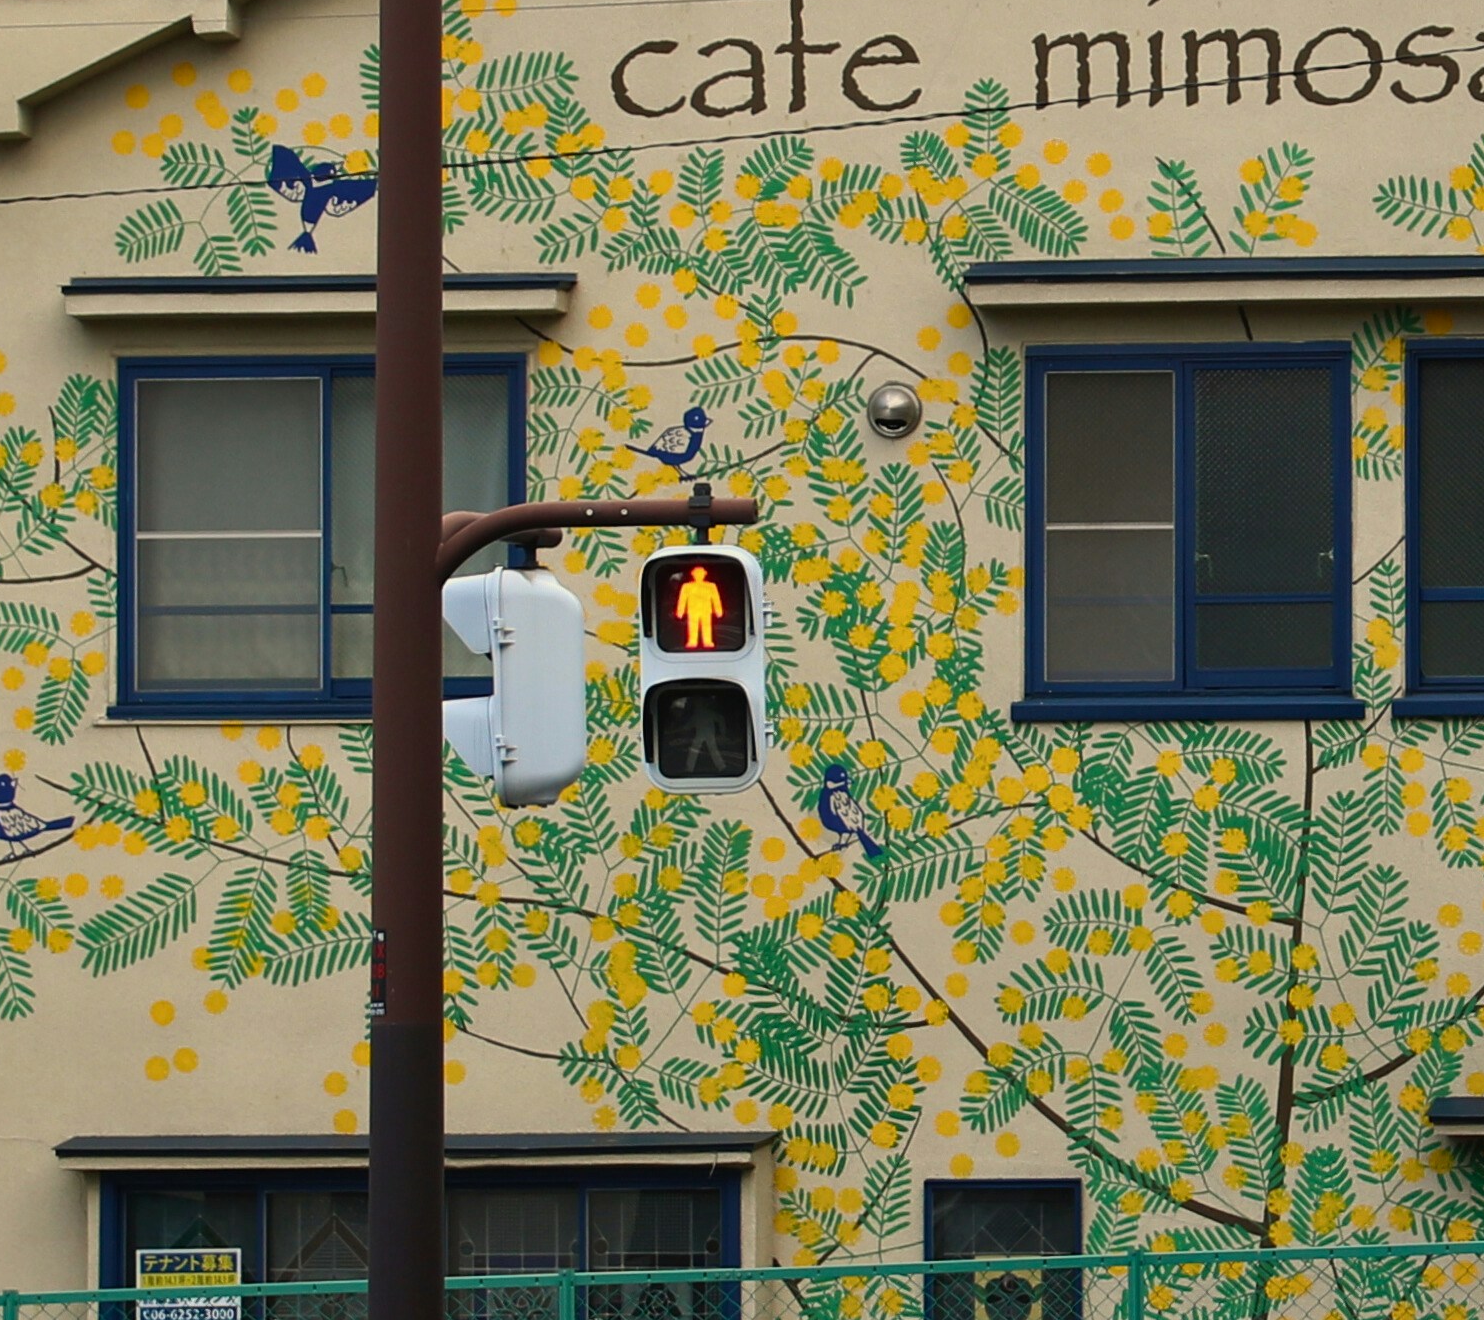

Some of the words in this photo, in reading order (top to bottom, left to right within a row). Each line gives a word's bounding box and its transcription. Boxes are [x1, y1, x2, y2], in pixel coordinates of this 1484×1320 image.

[144, 1254, 234, 1272] テナント募集
